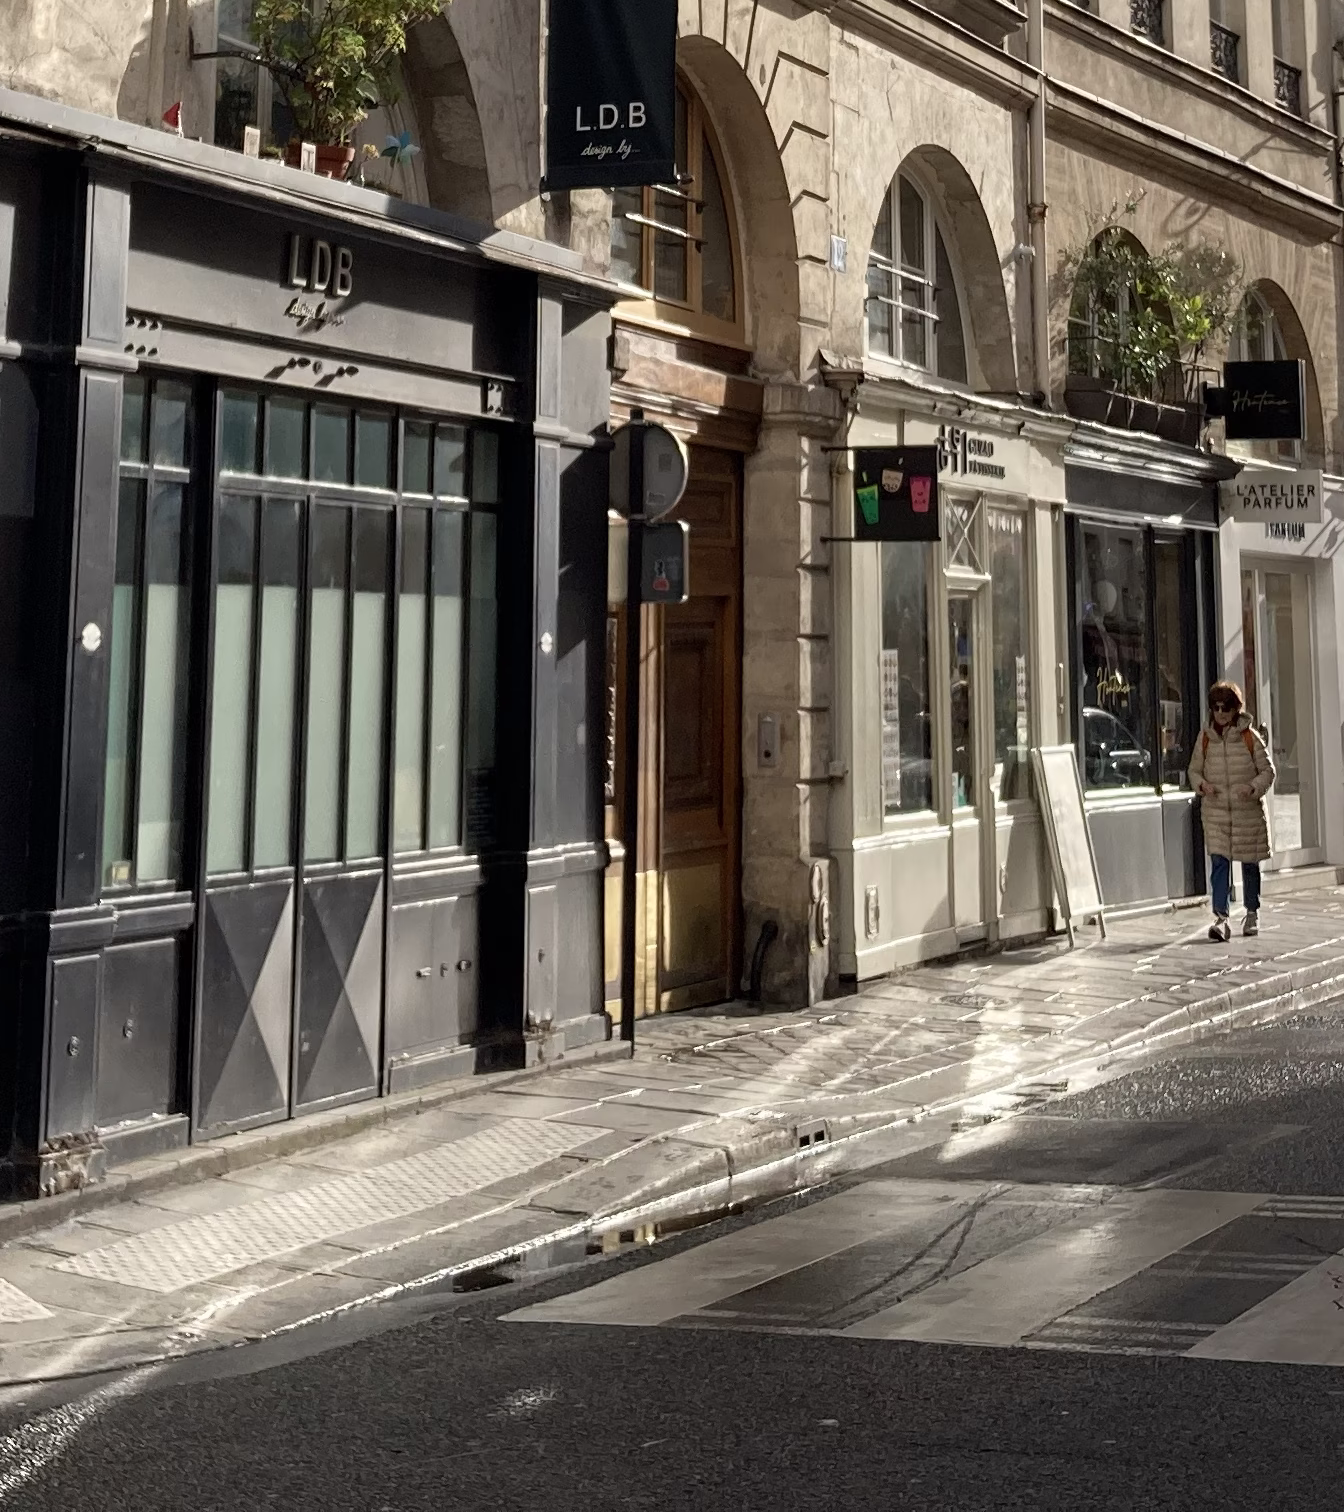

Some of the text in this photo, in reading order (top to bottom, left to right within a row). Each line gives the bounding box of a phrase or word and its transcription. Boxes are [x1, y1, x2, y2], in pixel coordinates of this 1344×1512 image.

[576, 102, 646, 131] L.D.B
[580, 142, 613, 160] design
[288, 235, 352, 296] LDB
[1236, 484, 1316, 497] L'ATELIER
[1243, 497, 1309, 510] PARFUM
